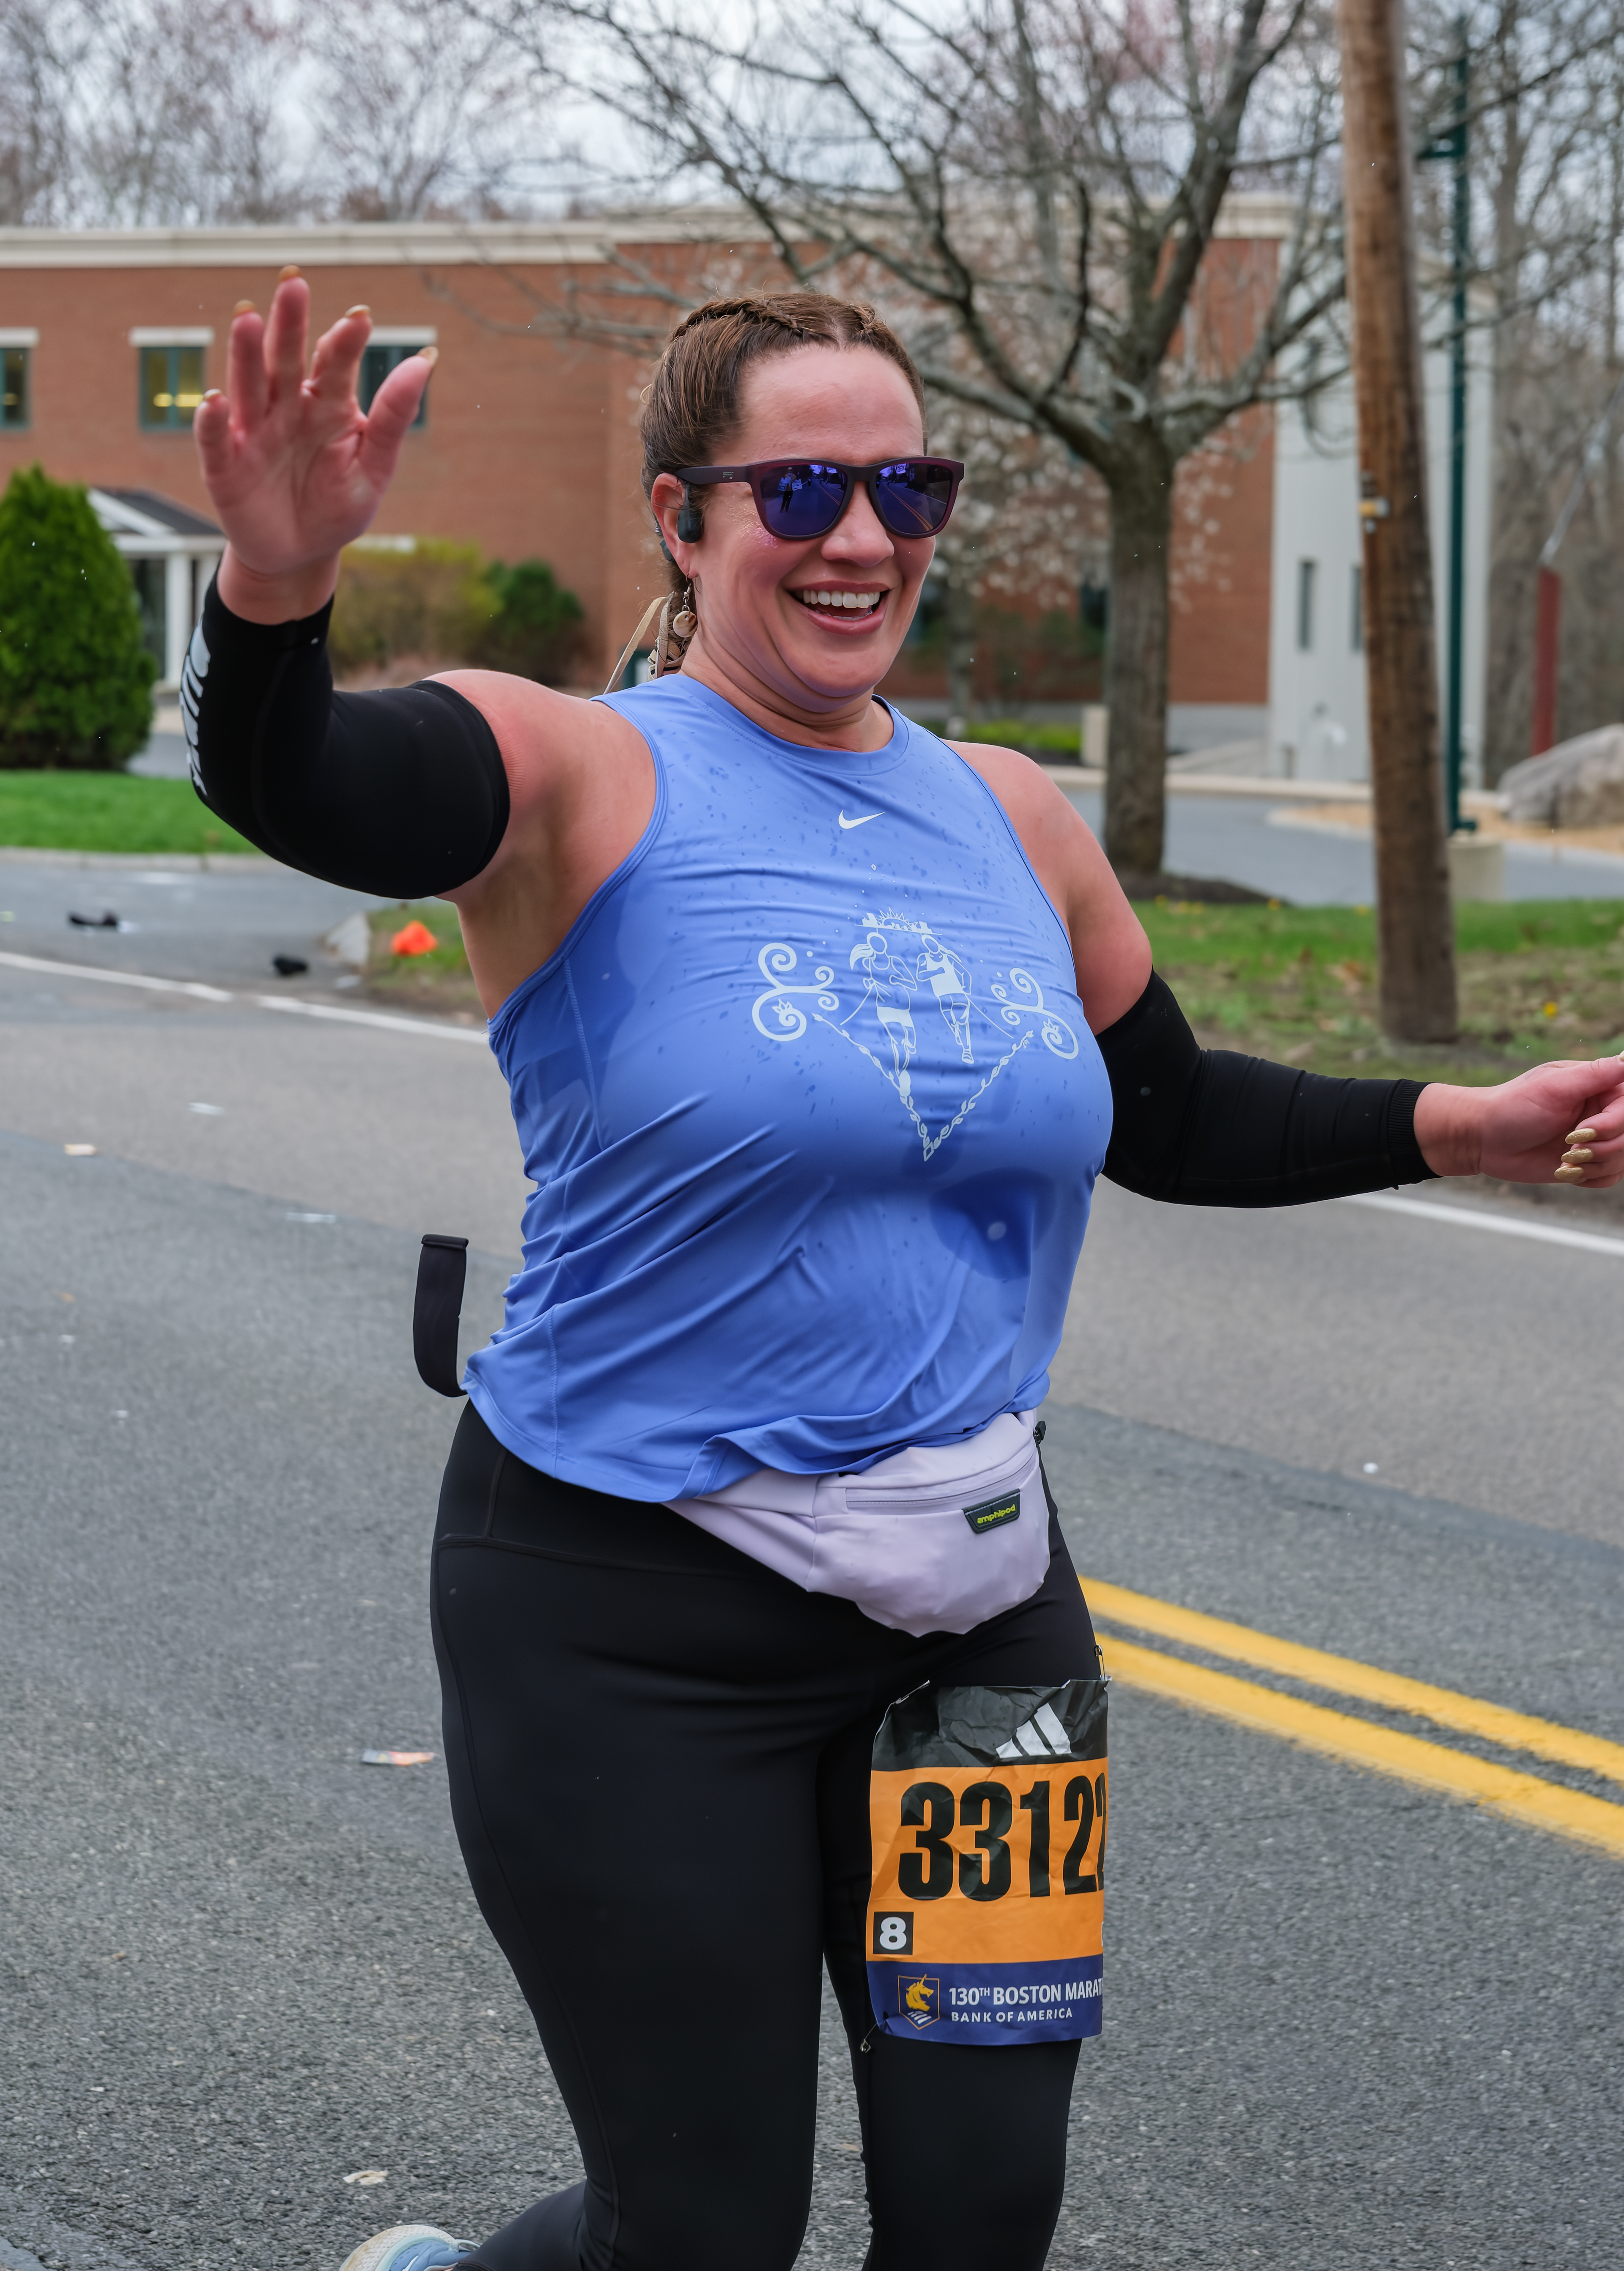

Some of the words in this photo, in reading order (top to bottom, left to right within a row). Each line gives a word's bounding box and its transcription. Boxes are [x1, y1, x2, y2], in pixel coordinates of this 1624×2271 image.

[977, 1504, 1016, 1524] amphipod
[880, 1916, 907, 1950] 8
[949, 1987, 990, 2005] 130TH
[993, 1984, 1061, 2005] BOSTON
[1065, 1978, 1103, 2001] MARAT
[952, 2011, 991, 2023] BANK
[996, 2011, 1014, 2023] OF
[1018, 2007, 1073, 2022] AMERICA
